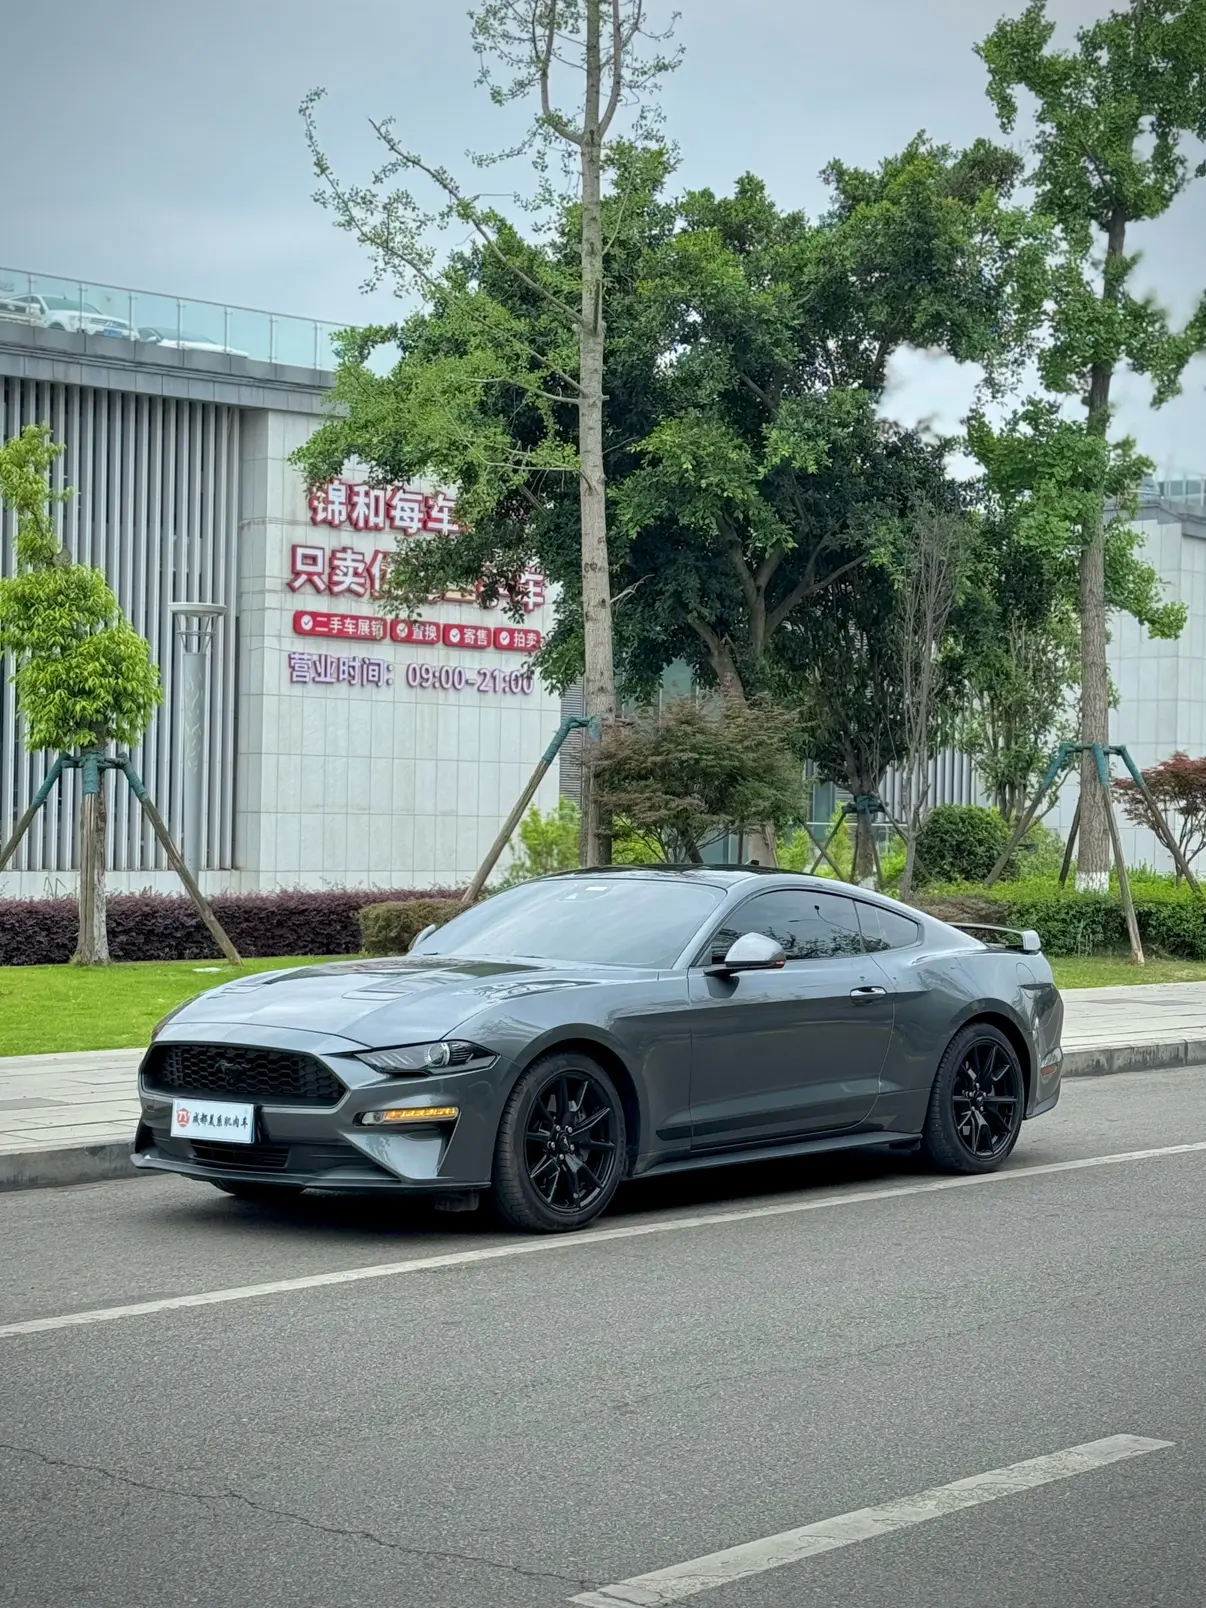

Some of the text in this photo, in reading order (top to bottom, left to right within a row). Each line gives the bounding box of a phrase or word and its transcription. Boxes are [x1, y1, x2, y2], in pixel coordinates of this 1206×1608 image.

[315, 616, 539, 648] 二手车展销 置换 寄售 拍卖
[288, 652, 535, 694] 营业时间： 09:00-21:00
